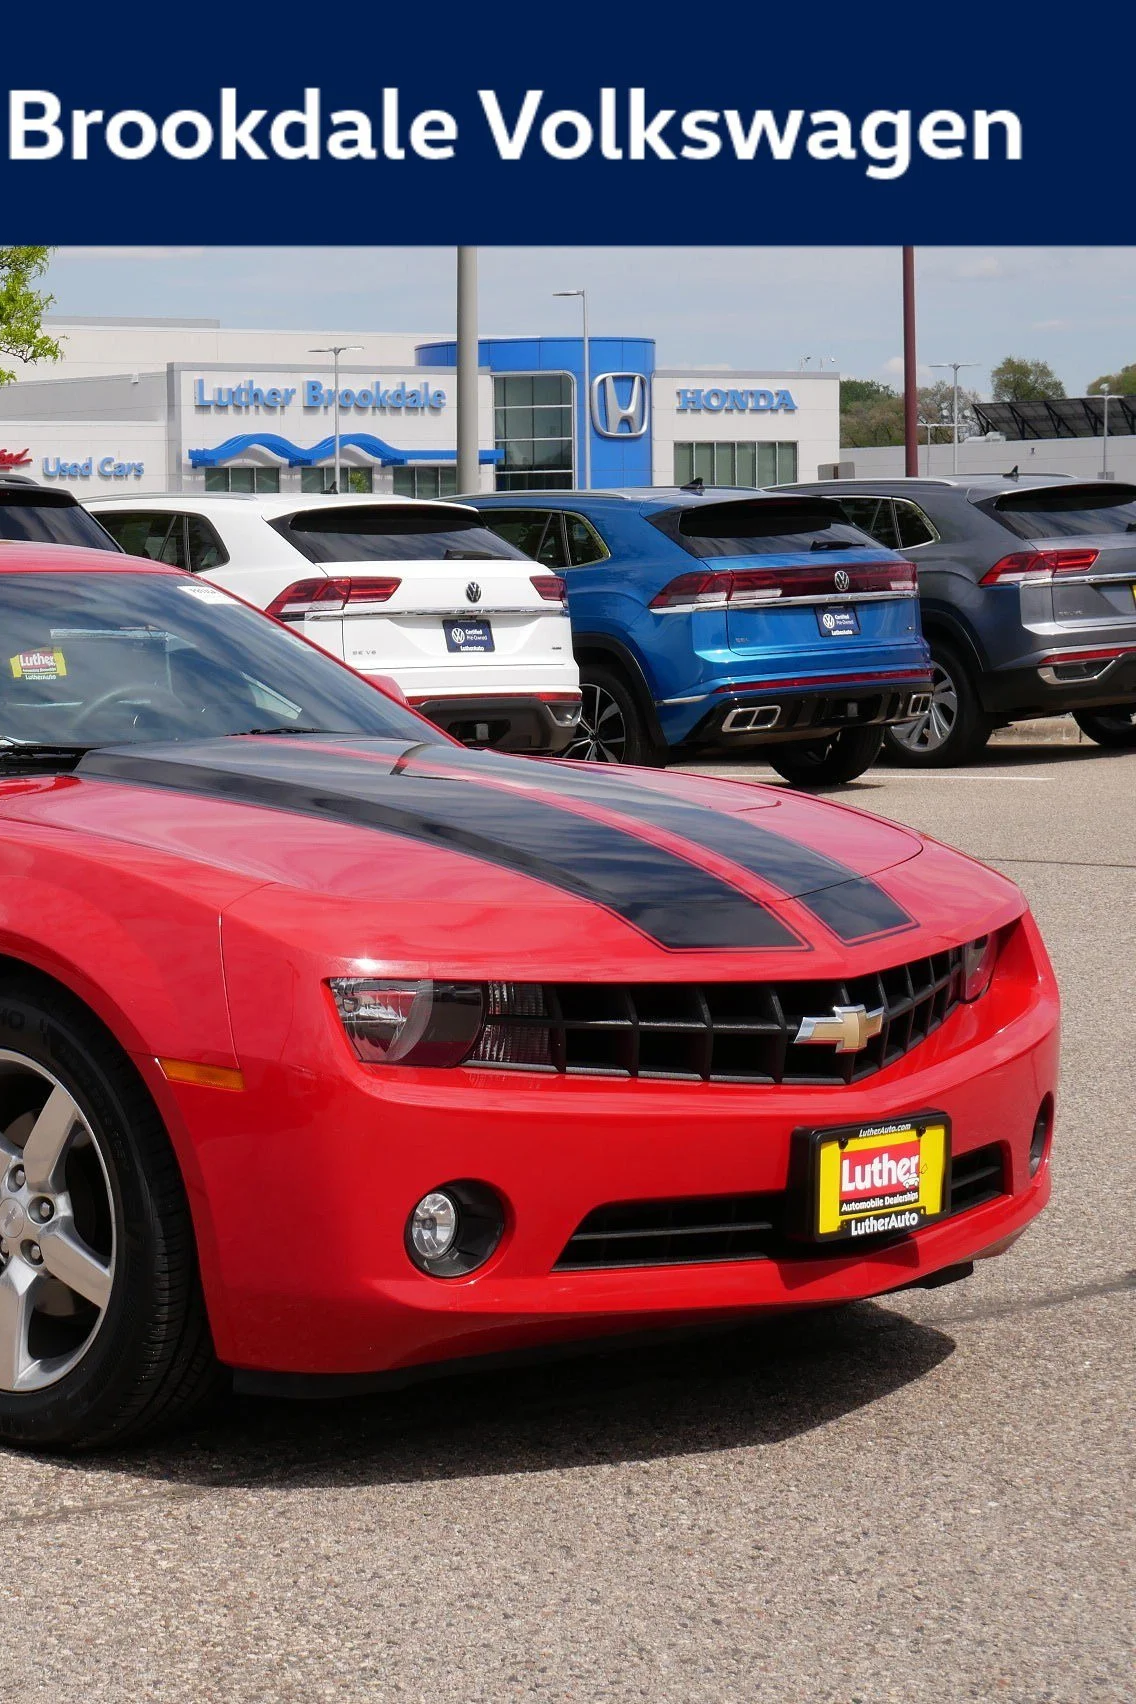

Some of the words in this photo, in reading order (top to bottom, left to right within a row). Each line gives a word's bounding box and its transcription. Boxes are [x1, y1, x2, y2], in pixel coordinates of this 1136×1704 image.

[194, 378, 296, 407] Luther
[304, 380, 446, 408] Brookdale
[676, 388, 798, 411] HONDA
[43, 457, 93, 476] Used
[98, 457, 145, 476] Cars
[19, 653, 56, 667] Luther
[859, 1123, 911, 1138] LutherAuto.com
[841, 1152, 920, 1192] Luther
[841, 1196, 884, 1212] Automobile
[884, 1191, 919, 1205] Dealerships
[851, 1212, 919, 1236] LutherAuto
